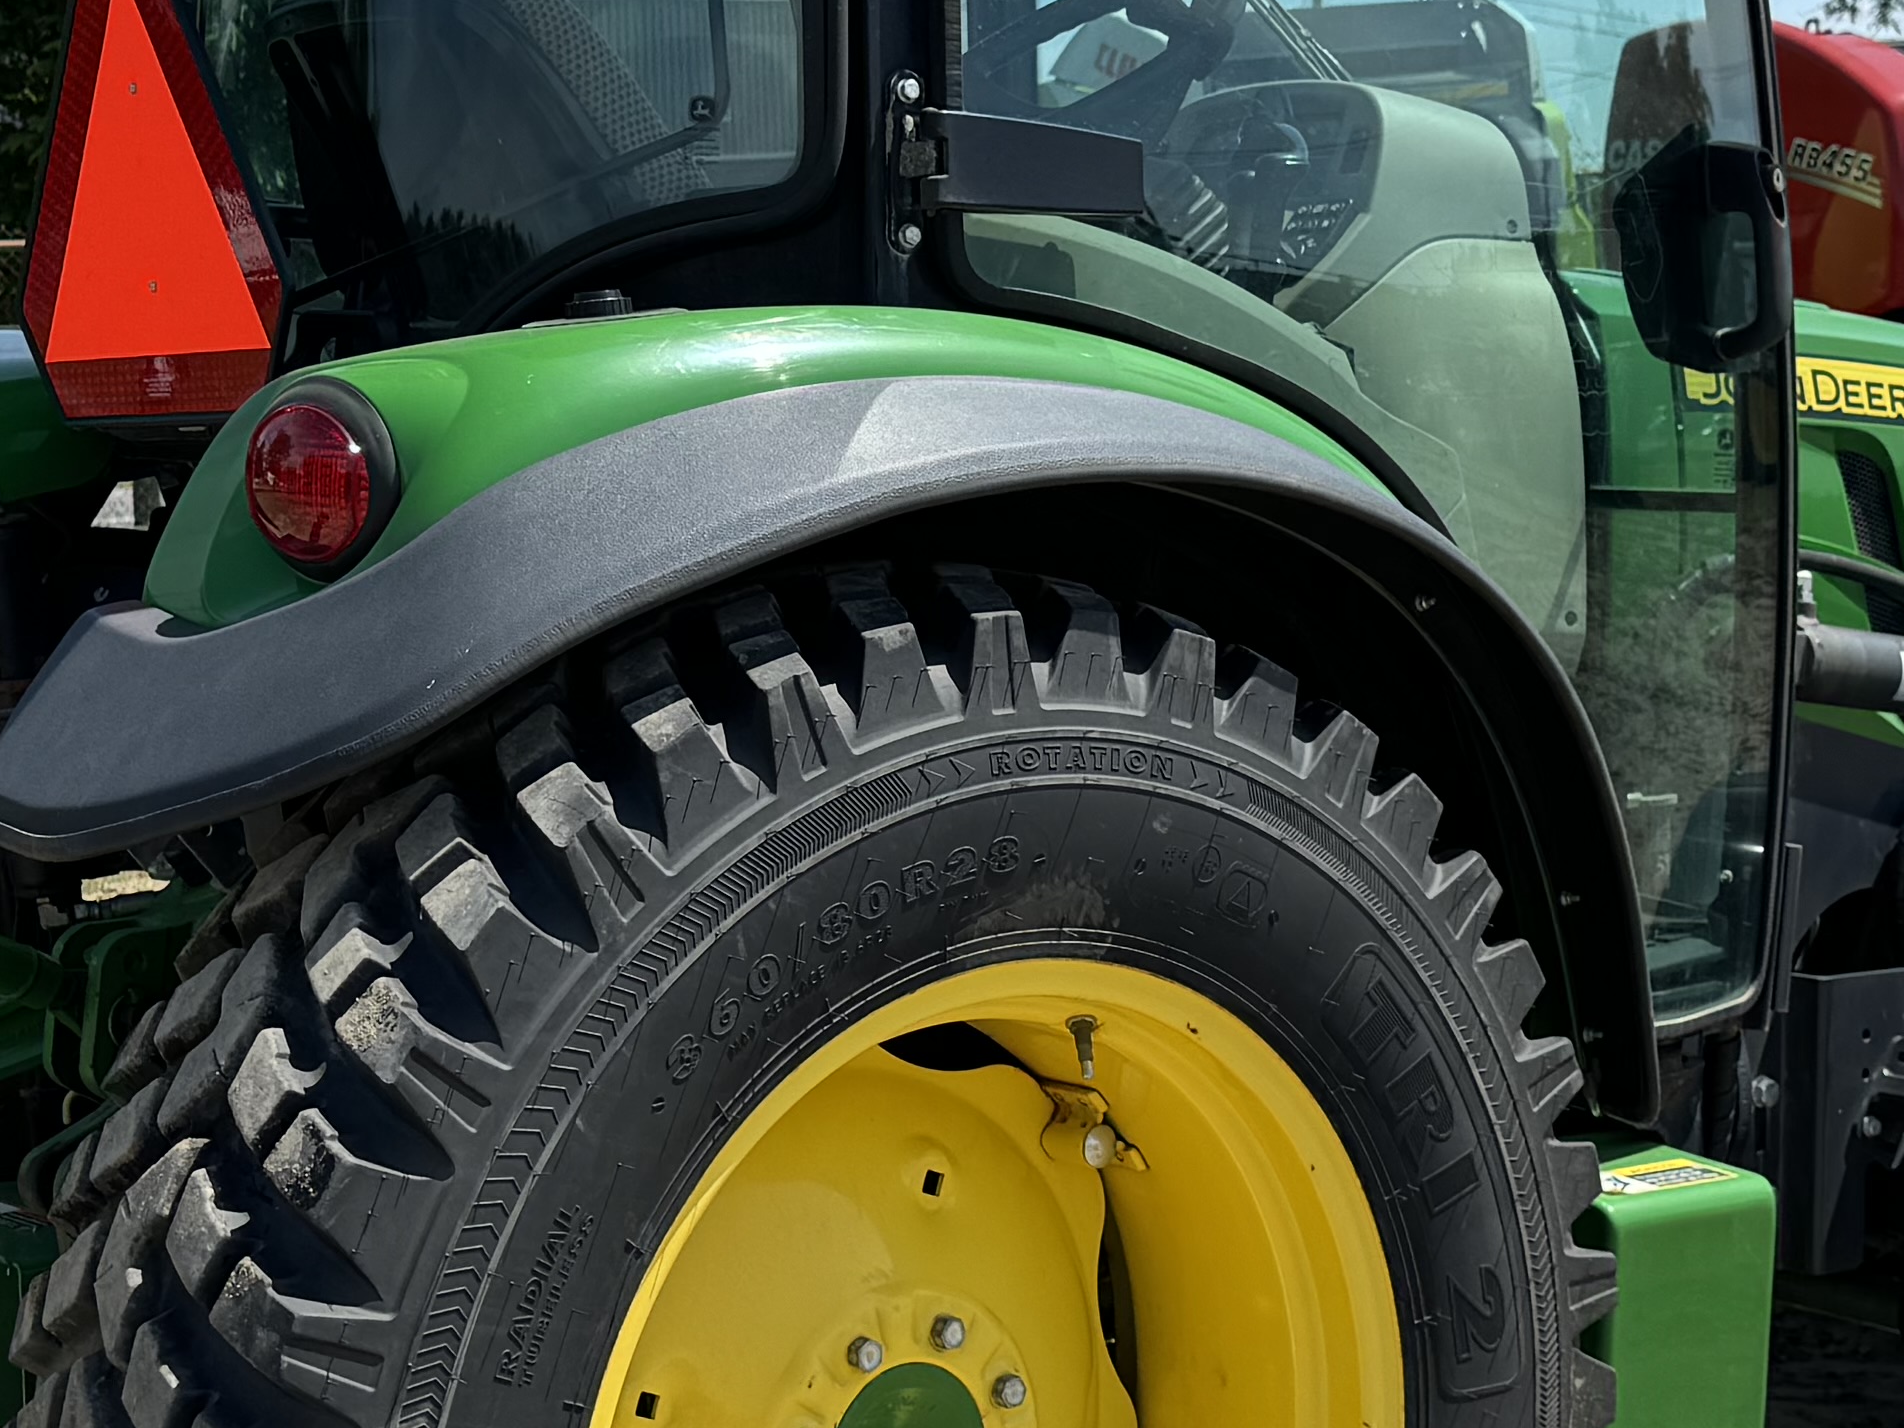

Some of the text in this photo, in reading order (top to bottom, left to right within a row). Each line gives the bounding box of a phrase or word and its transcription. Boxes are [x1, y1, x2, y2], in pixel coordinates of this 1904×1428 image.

[1790, 138, 1873, 183] RB455
[989, 745, 1173, 780] ROTATION
[1348, 973, 1505, 1364] TRI 2
[494, 1204, 581, 1387] RADIAL
